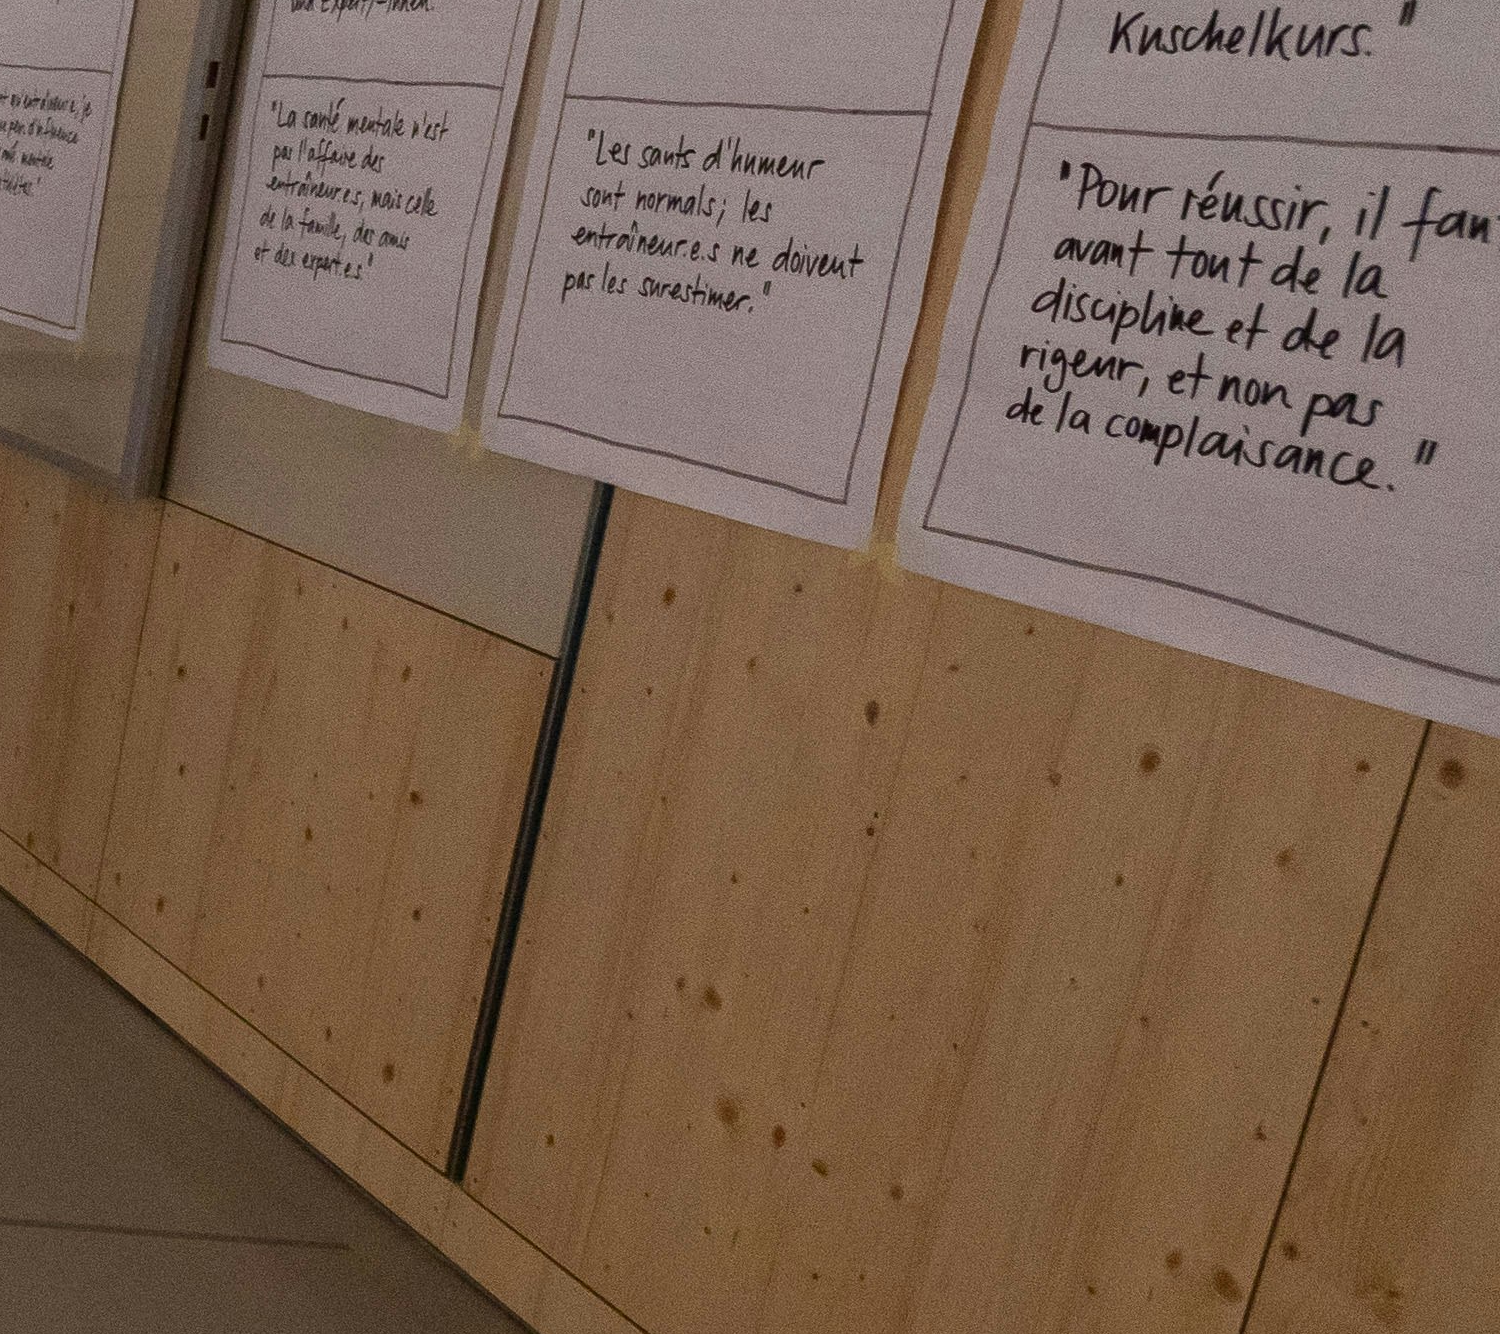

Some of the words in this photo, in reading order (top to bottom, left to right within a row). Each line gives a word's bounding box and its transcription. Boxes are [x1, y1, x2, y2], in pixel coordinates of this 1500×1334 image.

[302, 97, 345, 133] santé
[347, 106, 405, 138] mentale
[412, 110, 449, 141] n'est
[272, 145, 292, 172] pas
[361, 144, 384, 173] des
[588, 128, 631, 166] "Les
[703, 136, 825, 180] d'humeur
[371, 189, 401, 210] mais
[405, 187, 437, 217] celle
[581, 180, 625, 209] sont
[636, 184, 726, 227] normals;
[742, 189, 772, 223] les
[1059, 159, 1173, 212] "Pour
[1181, 170, 1331, 246] réussir,
[1354, 185, 1390, 240] il
[1401, 186, 1500, 263] fau
[260, 204, 276, 229] de
[281, 207, 294, 230] la
[299, 207, 347, 248] famille,
[353, 219, 375, 245] des
[378, 231, 410, 250] amis
[255, 245, 270, 263] et
[275, 242, 296, 266] des
[731, 245, 759, 268] ne
[772, 236, 864, 279] doivent
[1053, 229, 1155, 276] avant
[1165, 233, 1263, 287] tout
[1270, 245, 1320, 296] de
[1342, 250, 1388, 298] la
[561, 268, 594, 304] pas
[602, 262, 625, 294] les
[1030, 276, 1215, 344] discipline
[1225, 302, 1269, 351] et
[1282, 306, 1341, 359] de
[1361, 312, 1406, 367] la
[1005, 386, 1044, 426] de
[1055, 390, 1090, 435] la
[1019, 339, 1150, 398] rigeur,
[1168, 351, 1213, 399] et
[1216, 375, 1293, 410] non
[1301, 390, 1384, 439] pas
